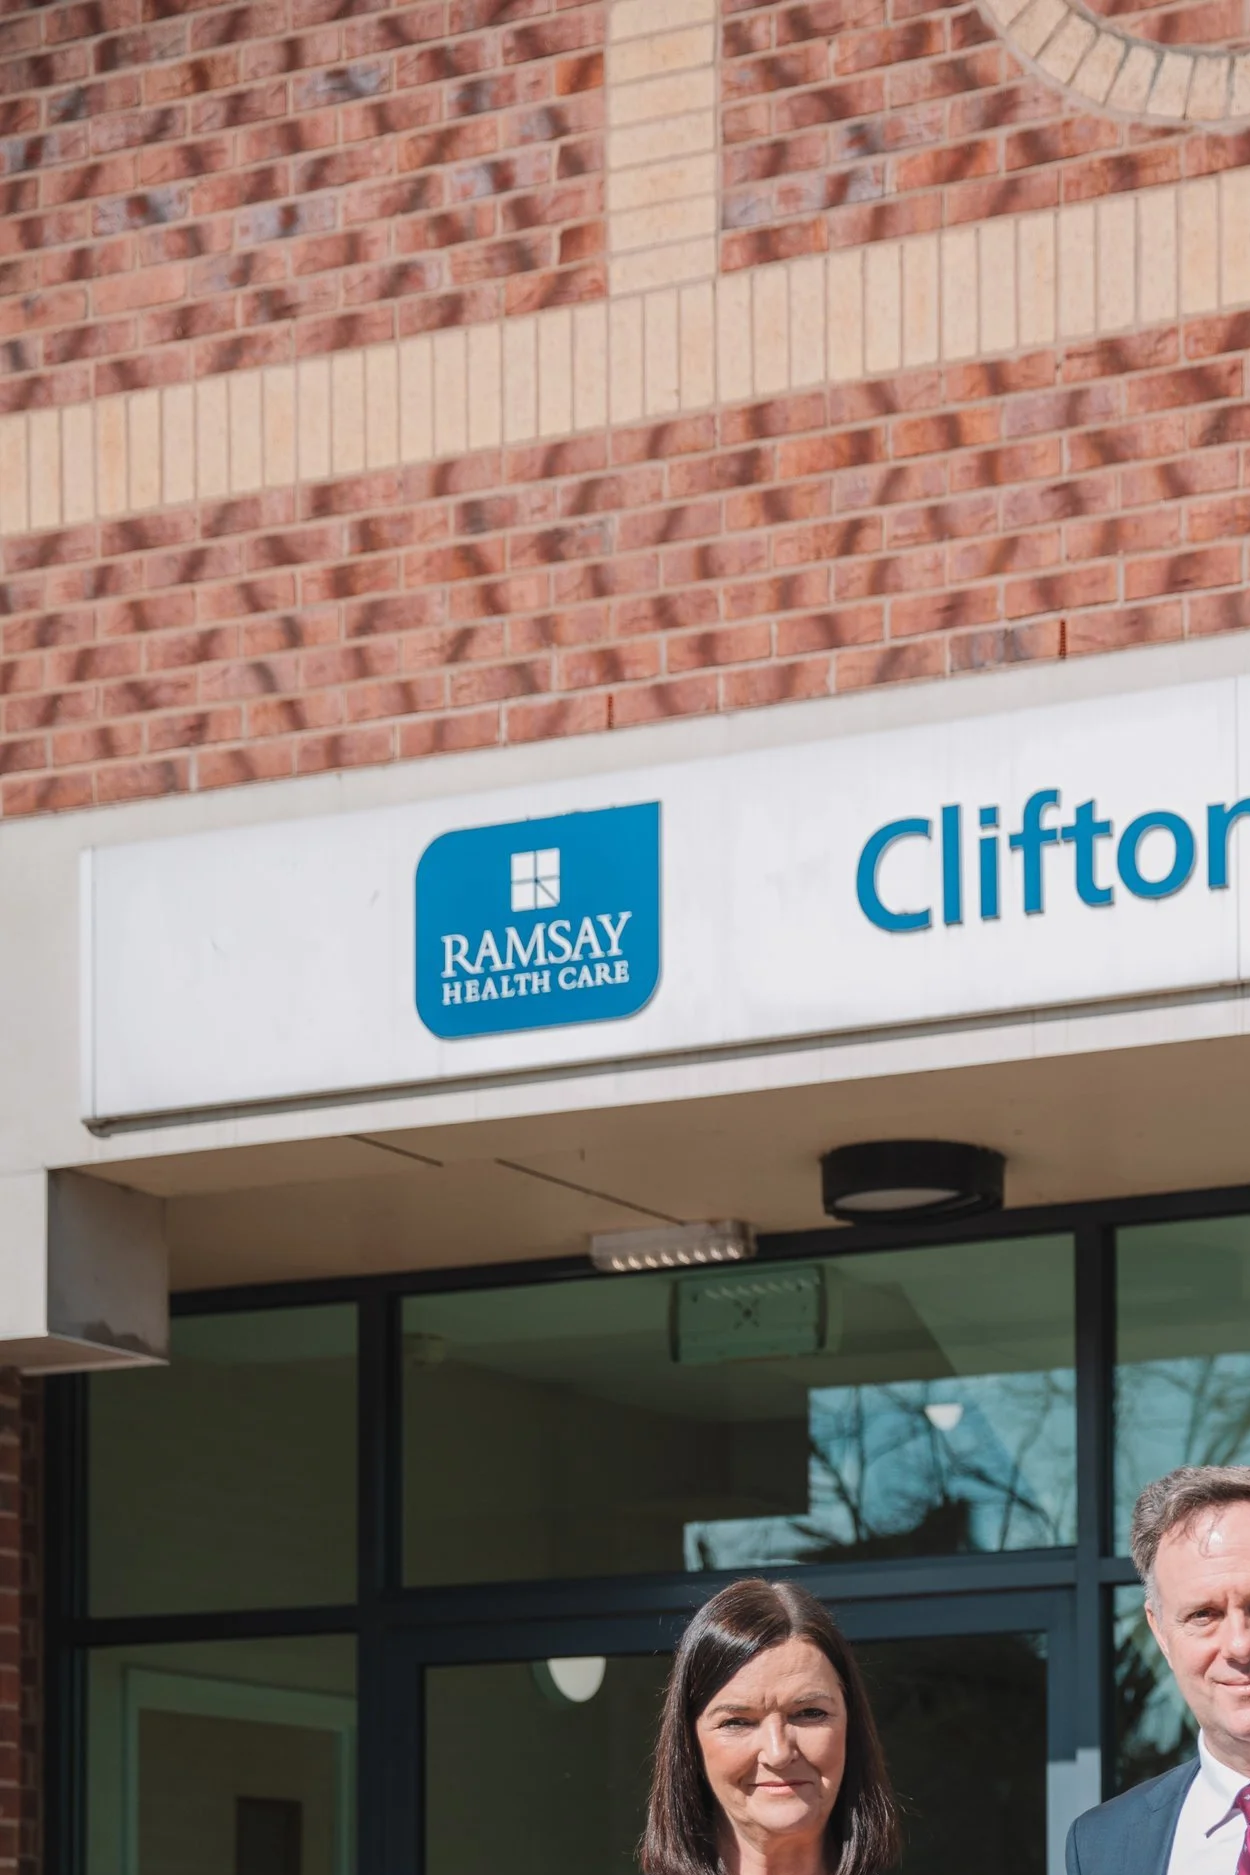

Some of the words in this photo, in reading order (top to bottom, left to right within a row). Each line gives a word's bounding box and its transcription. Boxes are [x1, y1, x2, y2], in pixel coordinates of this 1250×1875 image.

[440, 910, 633, 978] RAMSAY
[441, 969, 551, 1006] HEALTH
[558, 959, 630, 992] CARE
